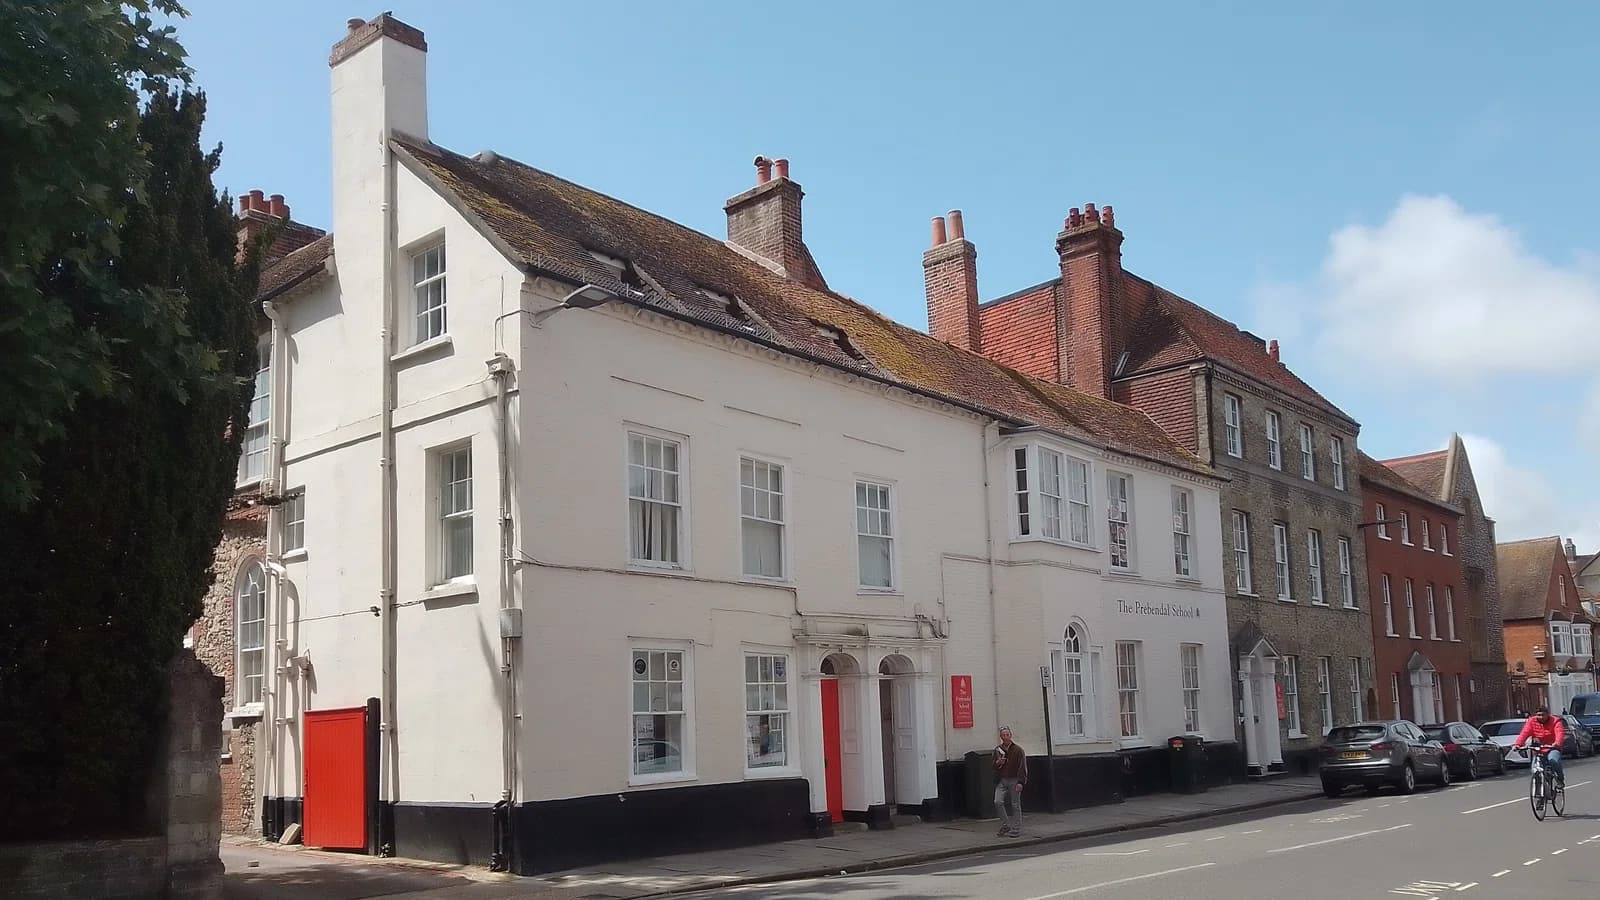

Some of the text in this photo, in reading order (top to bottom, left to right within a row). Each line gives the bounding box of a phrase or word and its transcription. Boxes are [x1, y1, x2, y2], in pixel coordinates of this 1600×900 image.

[1117, 599, 1194, 618] The Prebendal School
